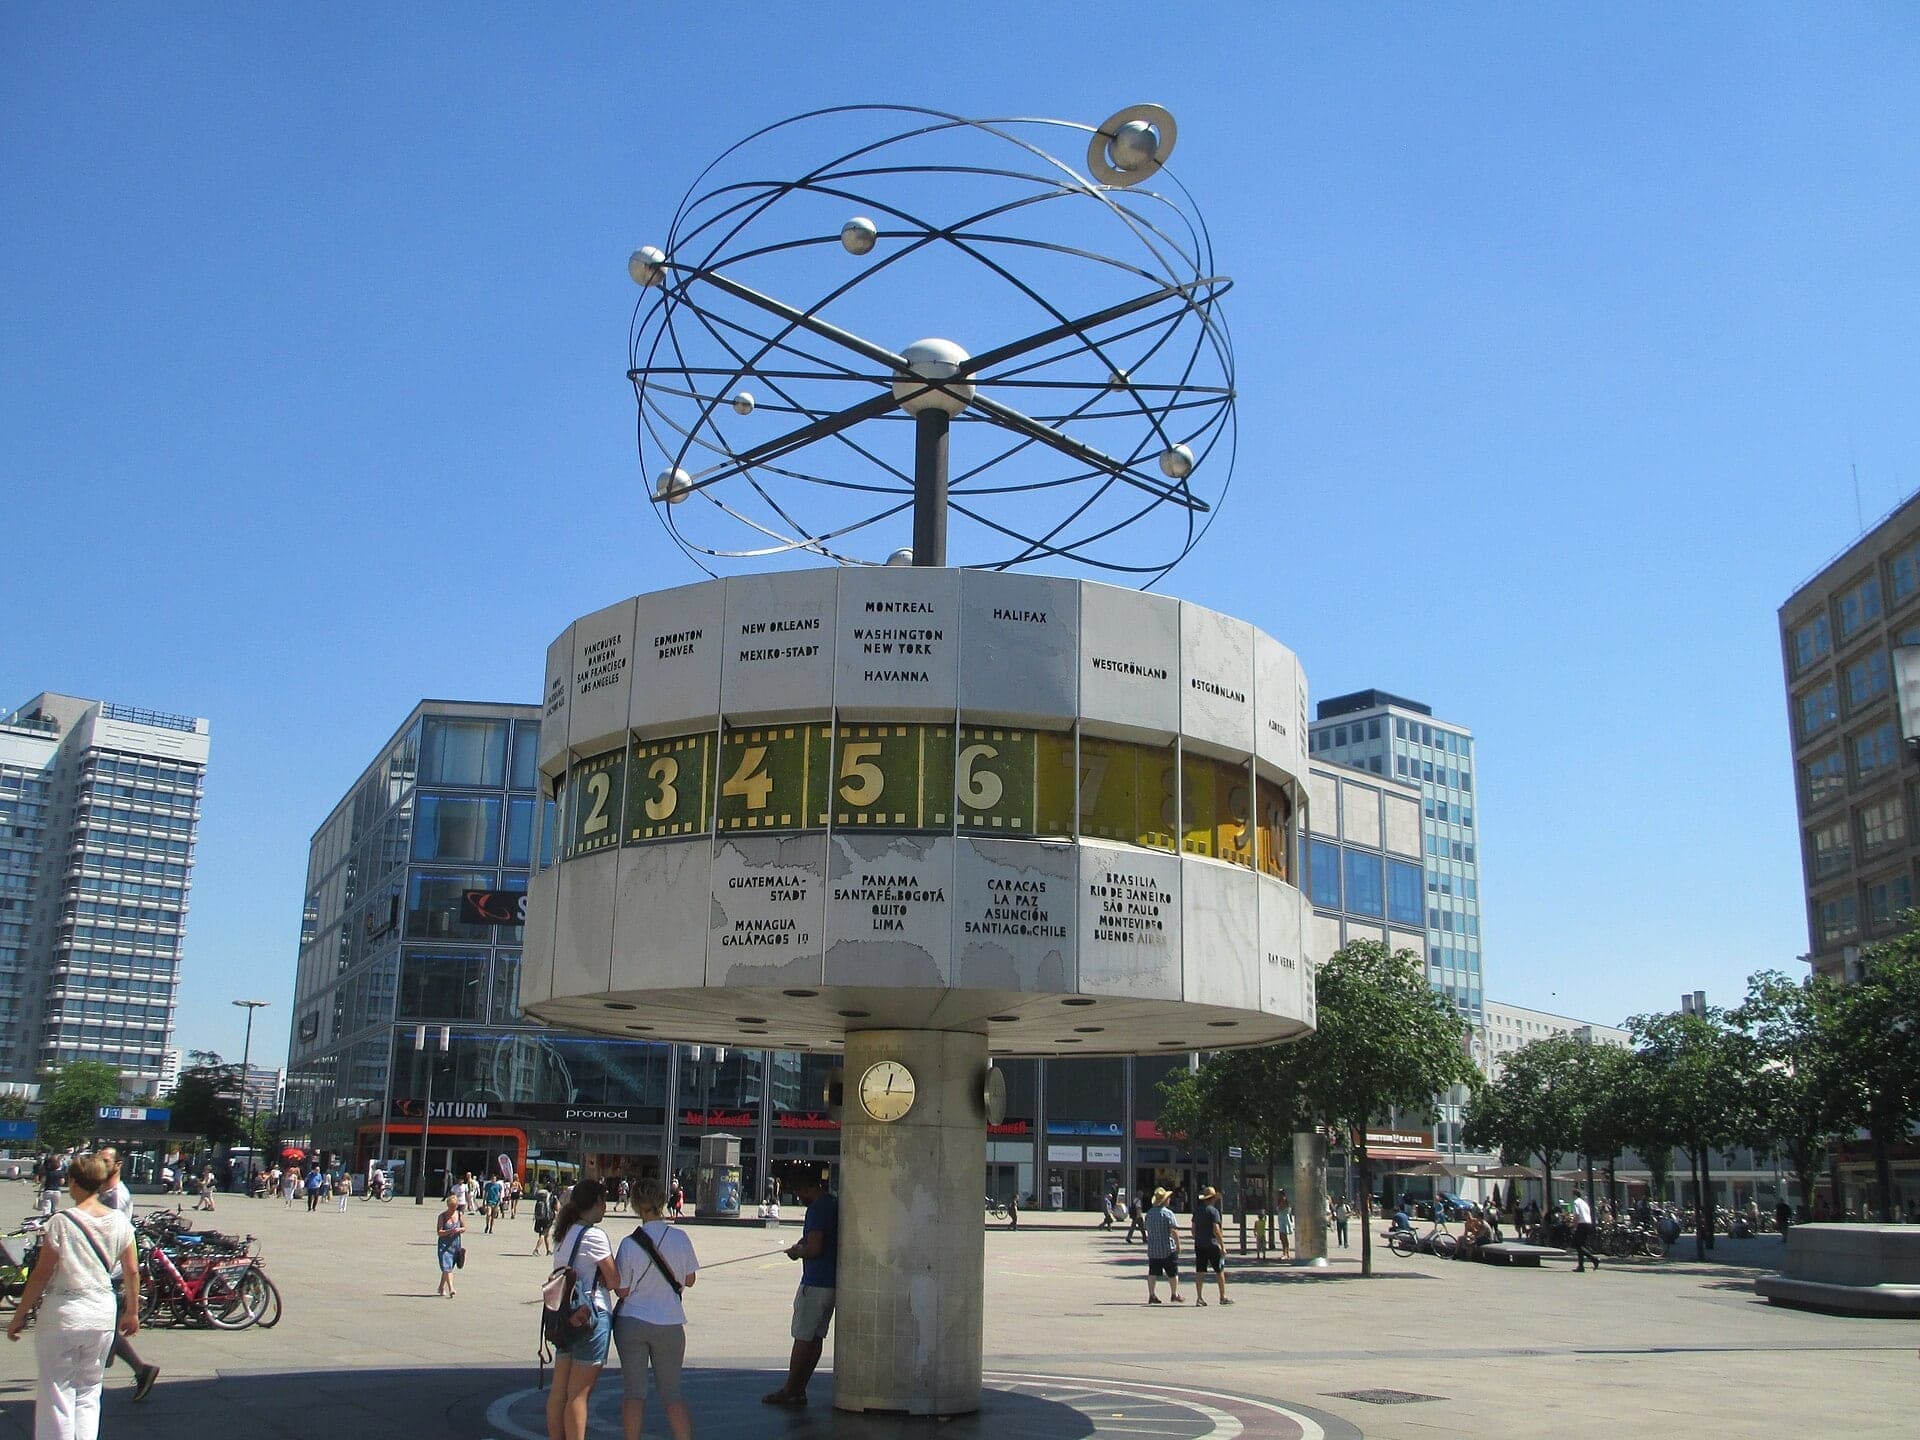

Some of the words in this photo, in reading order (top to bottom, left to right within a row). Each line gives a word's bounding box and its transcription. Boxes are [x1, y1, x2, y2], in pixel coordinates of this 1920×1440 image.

[866, 602, 934, 613] MONTREAL
[993, 608, 1047, 623] HALIFAX
[742, 622, 765, 635] NEW
[770, 618, 820, 632] ORLEANS
[654, 629, 703, 647] EDMONTON
[854, 629, 943, 640] WASHINGTON
[584, 634, 622, 656] VANCOUVER
[659, 644, 694, 659] DENVER
[864, 643, 892, 654] NEW
[898, 643, 932, 655] YORK
[588, 648, 616, 667] DAWSON
[740, 645, 820, 662] MEXIKO-STADT
[577, 670, 589, 684] SAN
[590, 657, 626, 678] FRANCISCO
[864, 670, 929, 682] HAVANNA
[1092, 657, 1167, 680] WESTGRÖNLAND
[581, 682, 591, 694] LOS
[592, 673, 619, 691] ANGELES
[722, 746, 773, 810] 4
[839, 742, 885, 807] 5
[958, 744, 1003, 810] 6
[645, 757, 680, 821] 3
[583, 771, 611, 835] 2
[862, 875, 918, 887] PANAMA
[987, 878, 1047, 893] CARACAS
[1106, 872, 1157, 889] BRASILIA
[770, 889, 807, 902] STADT
[994, 893, 1010, 905] LA
[1015, 895, 1038, 907] PAZ
[1090, 885, 1107, 897] RIO
[1111, 887, 1122, 898] DE
[1126, 888, 1172, 904] JANEIRO
[872, 904, 907, 916] QUITO
[984, 908, 1048, 922] ASUNCIÓN
[1128, 903, 1159, 916] PAULO
[735, 919, 796, 931] MANAGUA
[873, 919, 904, 930] LIMA
[1099, 915, 1163, 931] MONTEVIDEO
[722, 931, 789, 946] GALÁPAGOS
[1094, 929, 1134, 943] BUENOS
[100, 1107, 109, 1118] U
[428, 1101, 488, 1118] SATURN
[566, 1109, 628, 1119] promod
